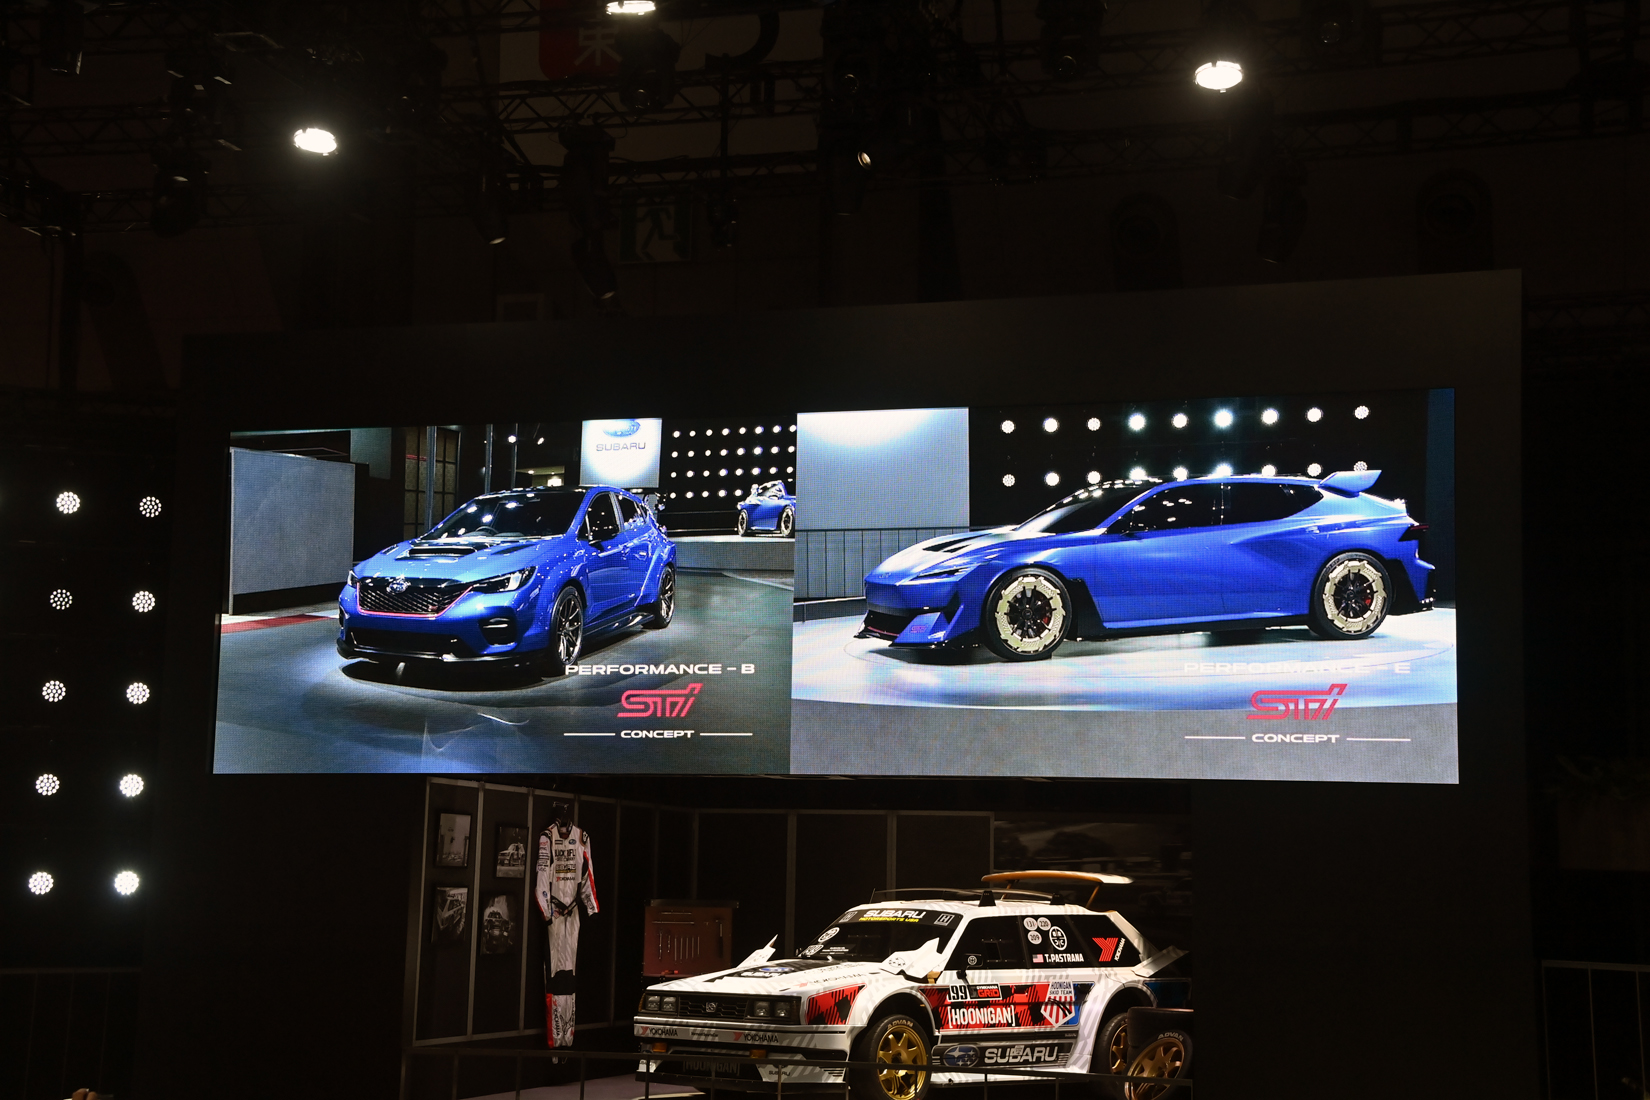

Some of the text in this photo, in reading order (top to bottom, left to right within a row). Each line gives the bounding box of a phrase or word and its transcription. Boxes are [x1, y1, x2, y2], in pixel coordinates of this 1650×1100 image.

[595, 442, 646, 452] SUBARU
[564, 663, 722, 676] PERFORMANCE
[741, 663, 755, 675] B
[1184, 662, 1371, 675] PERFORMANCE
[1394, 662, 1411, 674] E
[620, 730, 695, 739] CONCEPT
[1251, 733, 1340, 743] CONCEPT
[863, 909, 927, 919] SUBARU
[1050, 982, 1072, 990] HOONIGAN
[649, 1027, 678, 1037] YOKOHAMA
[1157, 1031, 1184, 1042] ADVAN
[743, 1033, 779, 1043] YOKOHAMA
[984, 1046, 1058, 1064] SUBARU
